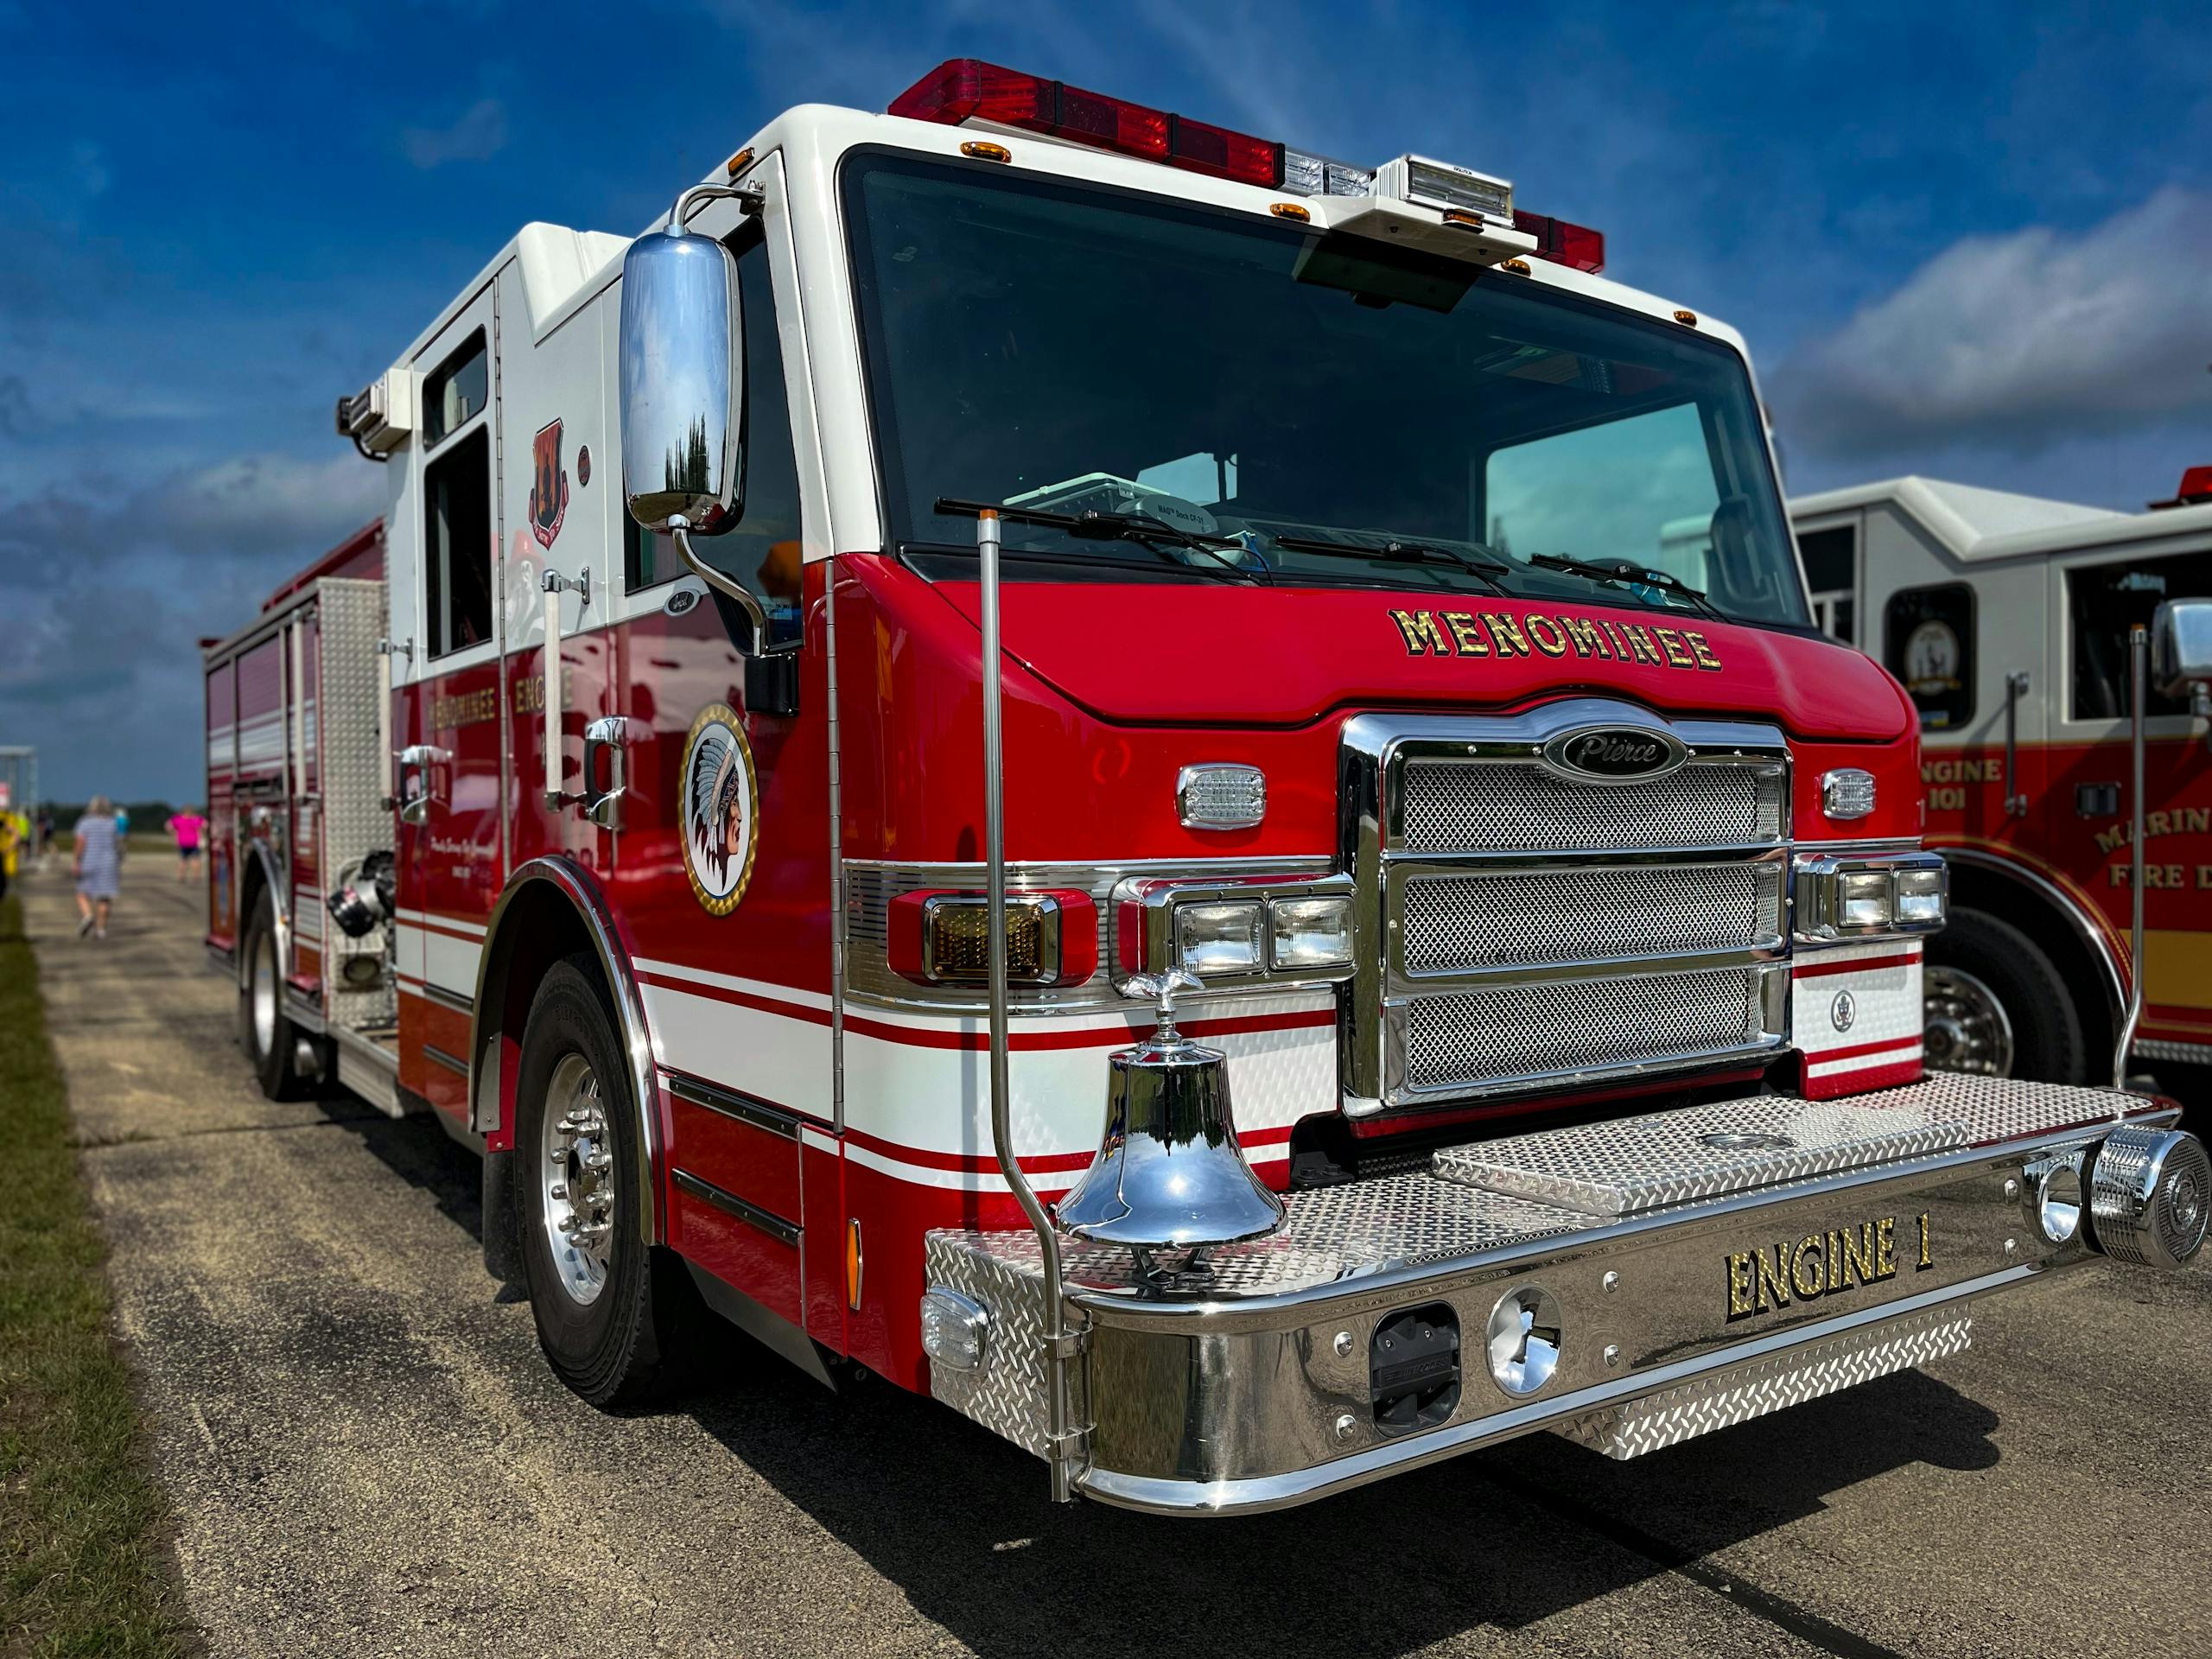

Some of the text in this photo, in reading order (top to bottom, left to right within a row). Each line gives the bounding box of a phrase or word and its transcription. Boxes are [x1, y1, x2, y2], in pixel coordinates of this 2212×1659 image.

[1389, 609, 1723, 672] MENOMINEE
[516, 669, 572, 714] ENGE
[1576, 735, 1658, 766] Pierce
[2109, 863, 2184, 888] FRE
[1725, 1210, 1933, 1325] ENGINE 1
